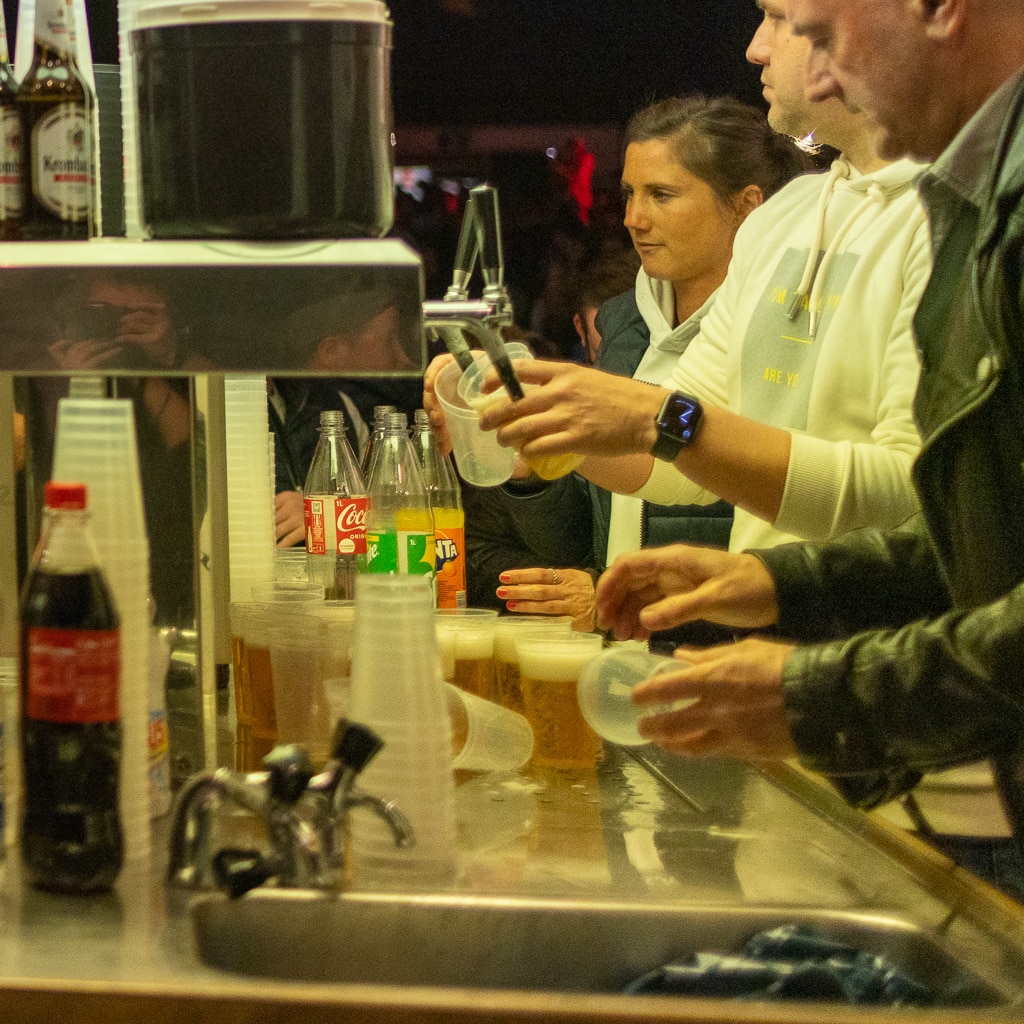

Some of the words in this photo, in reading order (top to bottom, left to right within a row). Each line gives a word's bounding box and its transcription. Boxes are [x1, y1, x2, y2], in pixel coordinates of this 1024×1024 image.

[763, 367, 782, 383] ARE
[787, 373, 799, 387] YO
[435, 538, 458, 560] NTA
